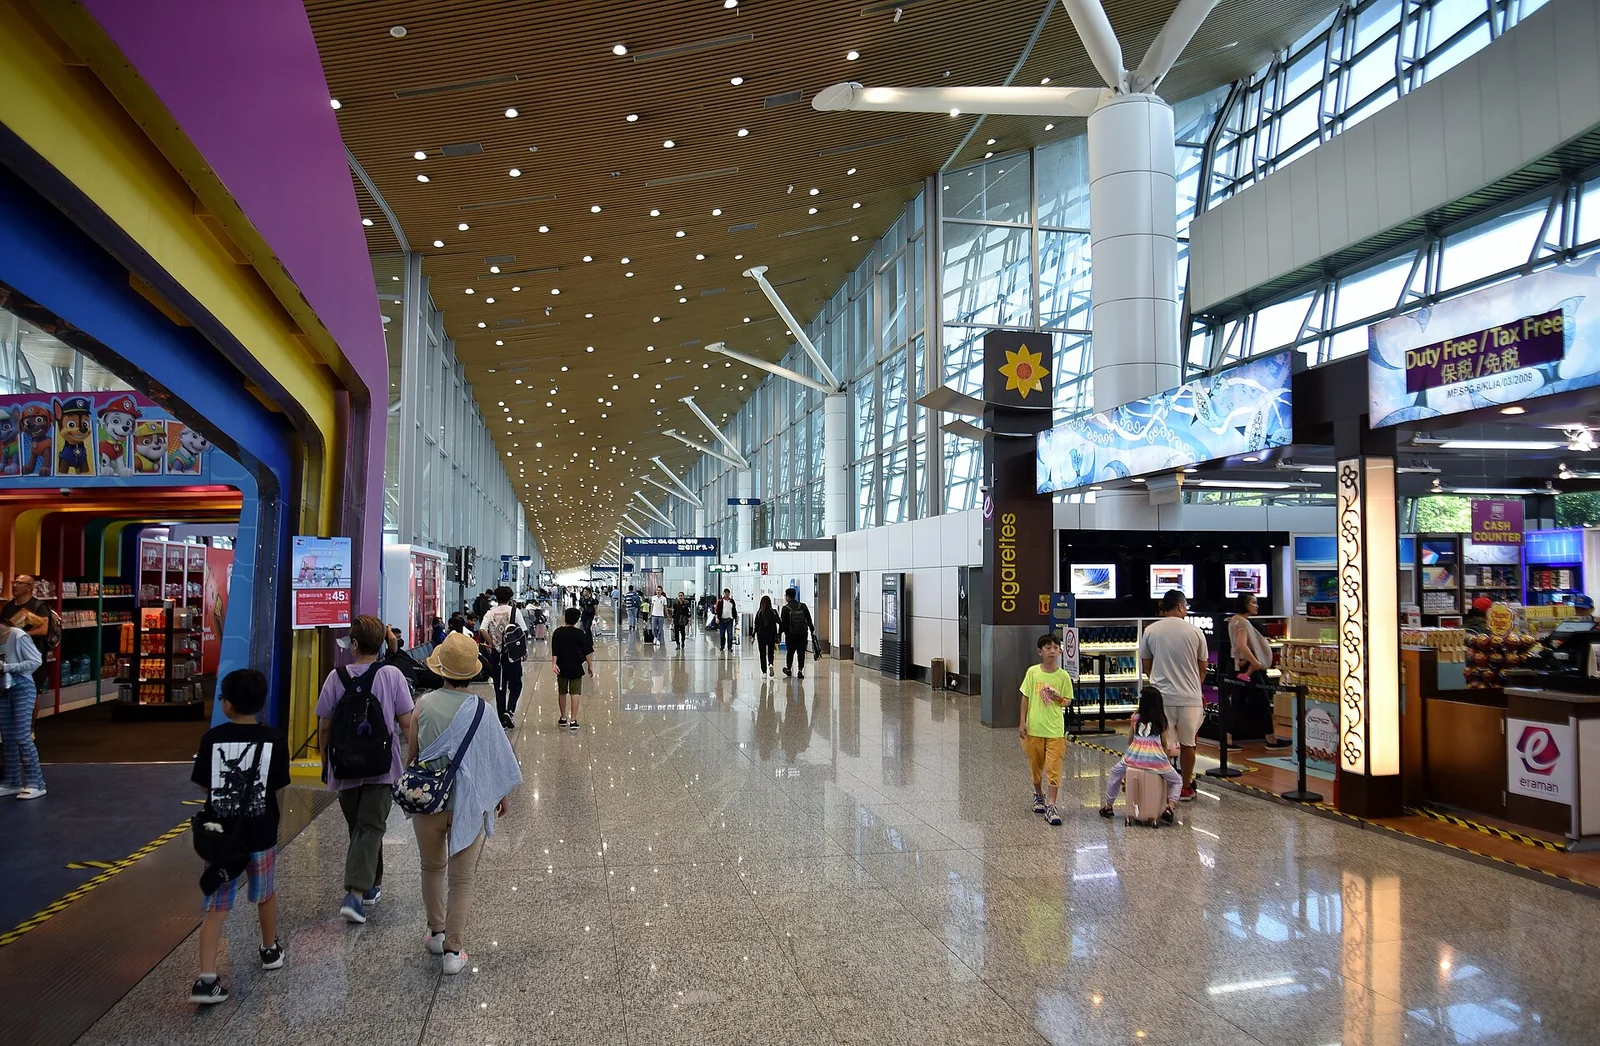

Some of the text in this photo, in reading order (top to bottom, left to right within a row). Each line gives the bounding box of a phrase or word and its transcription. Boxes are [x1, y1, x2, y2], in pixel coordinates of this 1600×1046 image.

[1406, 314, 1564, 370] Duty Free / Tax Free
[1483, 520, 1511, 531] CASH
[1473, 531, 1522, 542] COUNTER
[999, 512, 1021, 613] cigarettes
[331, 590, 345, 601] 45
[1520, 777, 1559, 793] eraman
